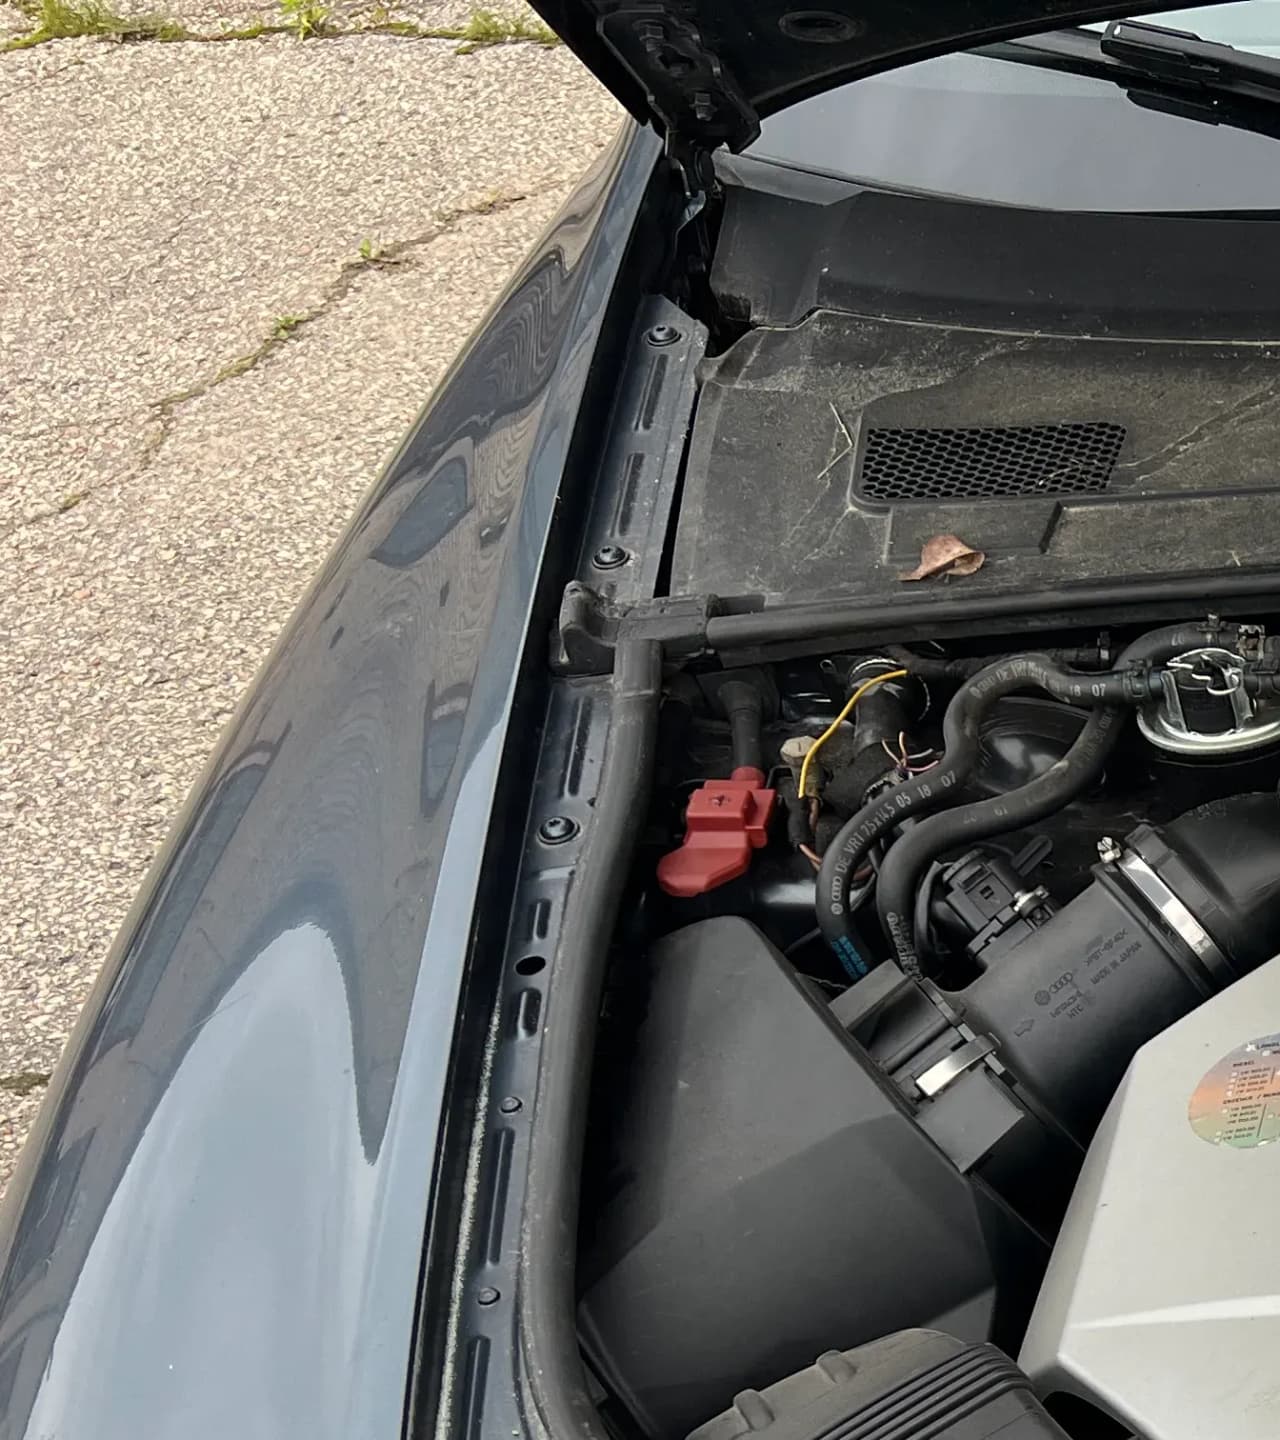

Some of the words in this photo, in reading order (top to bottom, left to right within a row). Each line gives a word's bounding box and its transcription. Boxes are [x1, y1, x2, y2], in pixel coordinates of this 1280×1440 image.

[1091, 683, 1106, 697] 07
[895, 793, 912, 809] 05
[916, 784, 933, 800] 18
[940, 770, 957, 788] 07
